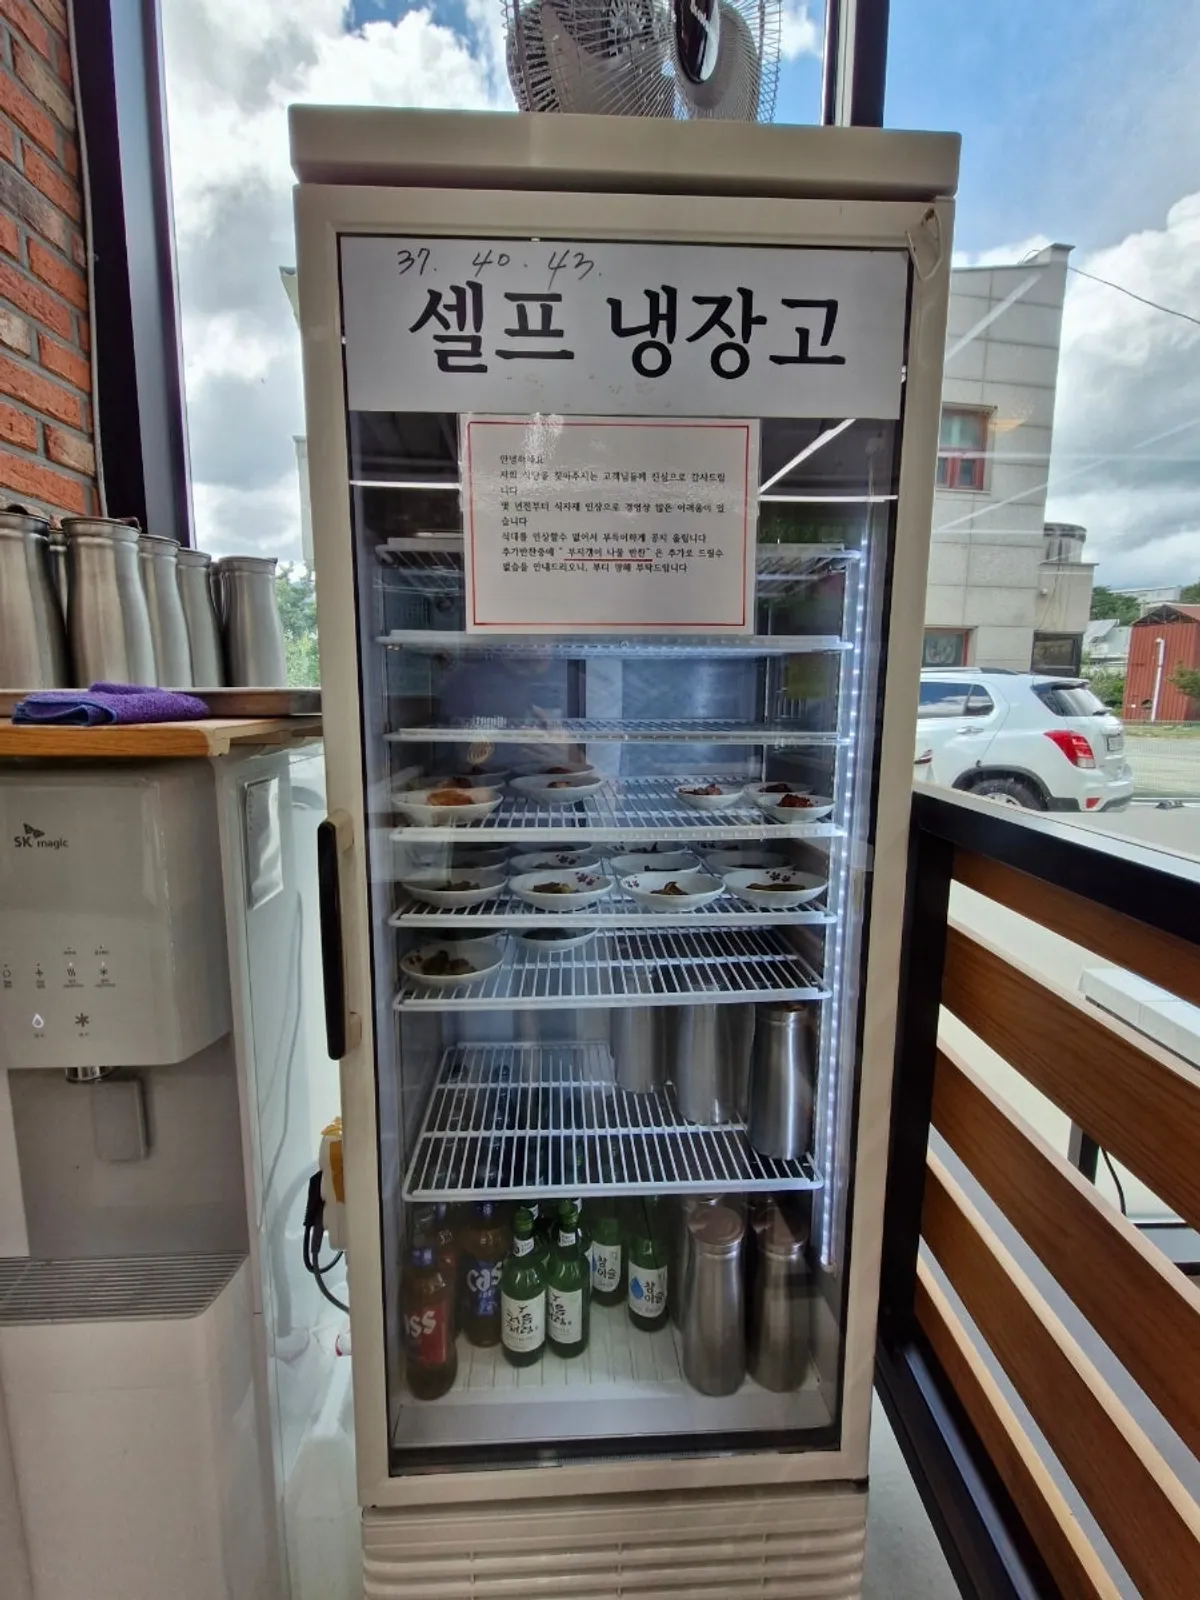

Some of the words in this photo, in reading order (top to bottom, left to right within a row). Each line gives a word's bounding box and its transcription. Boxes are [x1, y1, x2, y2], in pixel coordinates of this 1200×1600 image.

[409, 280, 575, 374] 셀프
[606, 284, 847, 380] 냉장고
[603, 471, 647, 483] 고객님들께
[651, 471, 687, 484] 진심으로
[514, 501, 550, 513] 년전부터
[554, 501, 581, 513] 식자재
[585, 502, 621, 513] 인상으로
[624, 502, 652, 513] 경영상
[501, 515, 529, 528] 습니다
[501, 532, 528, 544] 식대를
[571, 532, 598, 544] 없어서
[602, 532, 647, 544] 부득이하게
[651, 532, 668, 544] 공지
[671, 533, 707, 545] 올립니다
[667, 547, 695, 559] 추가로
[592, 561, 611, 574] 부디
[635, 561, 688, 574] 부탁드립니다
[14, 836, 33, 848] SK
[37, 837, 69, 850] magic
[467, 1261, 503, 1292] Cas
